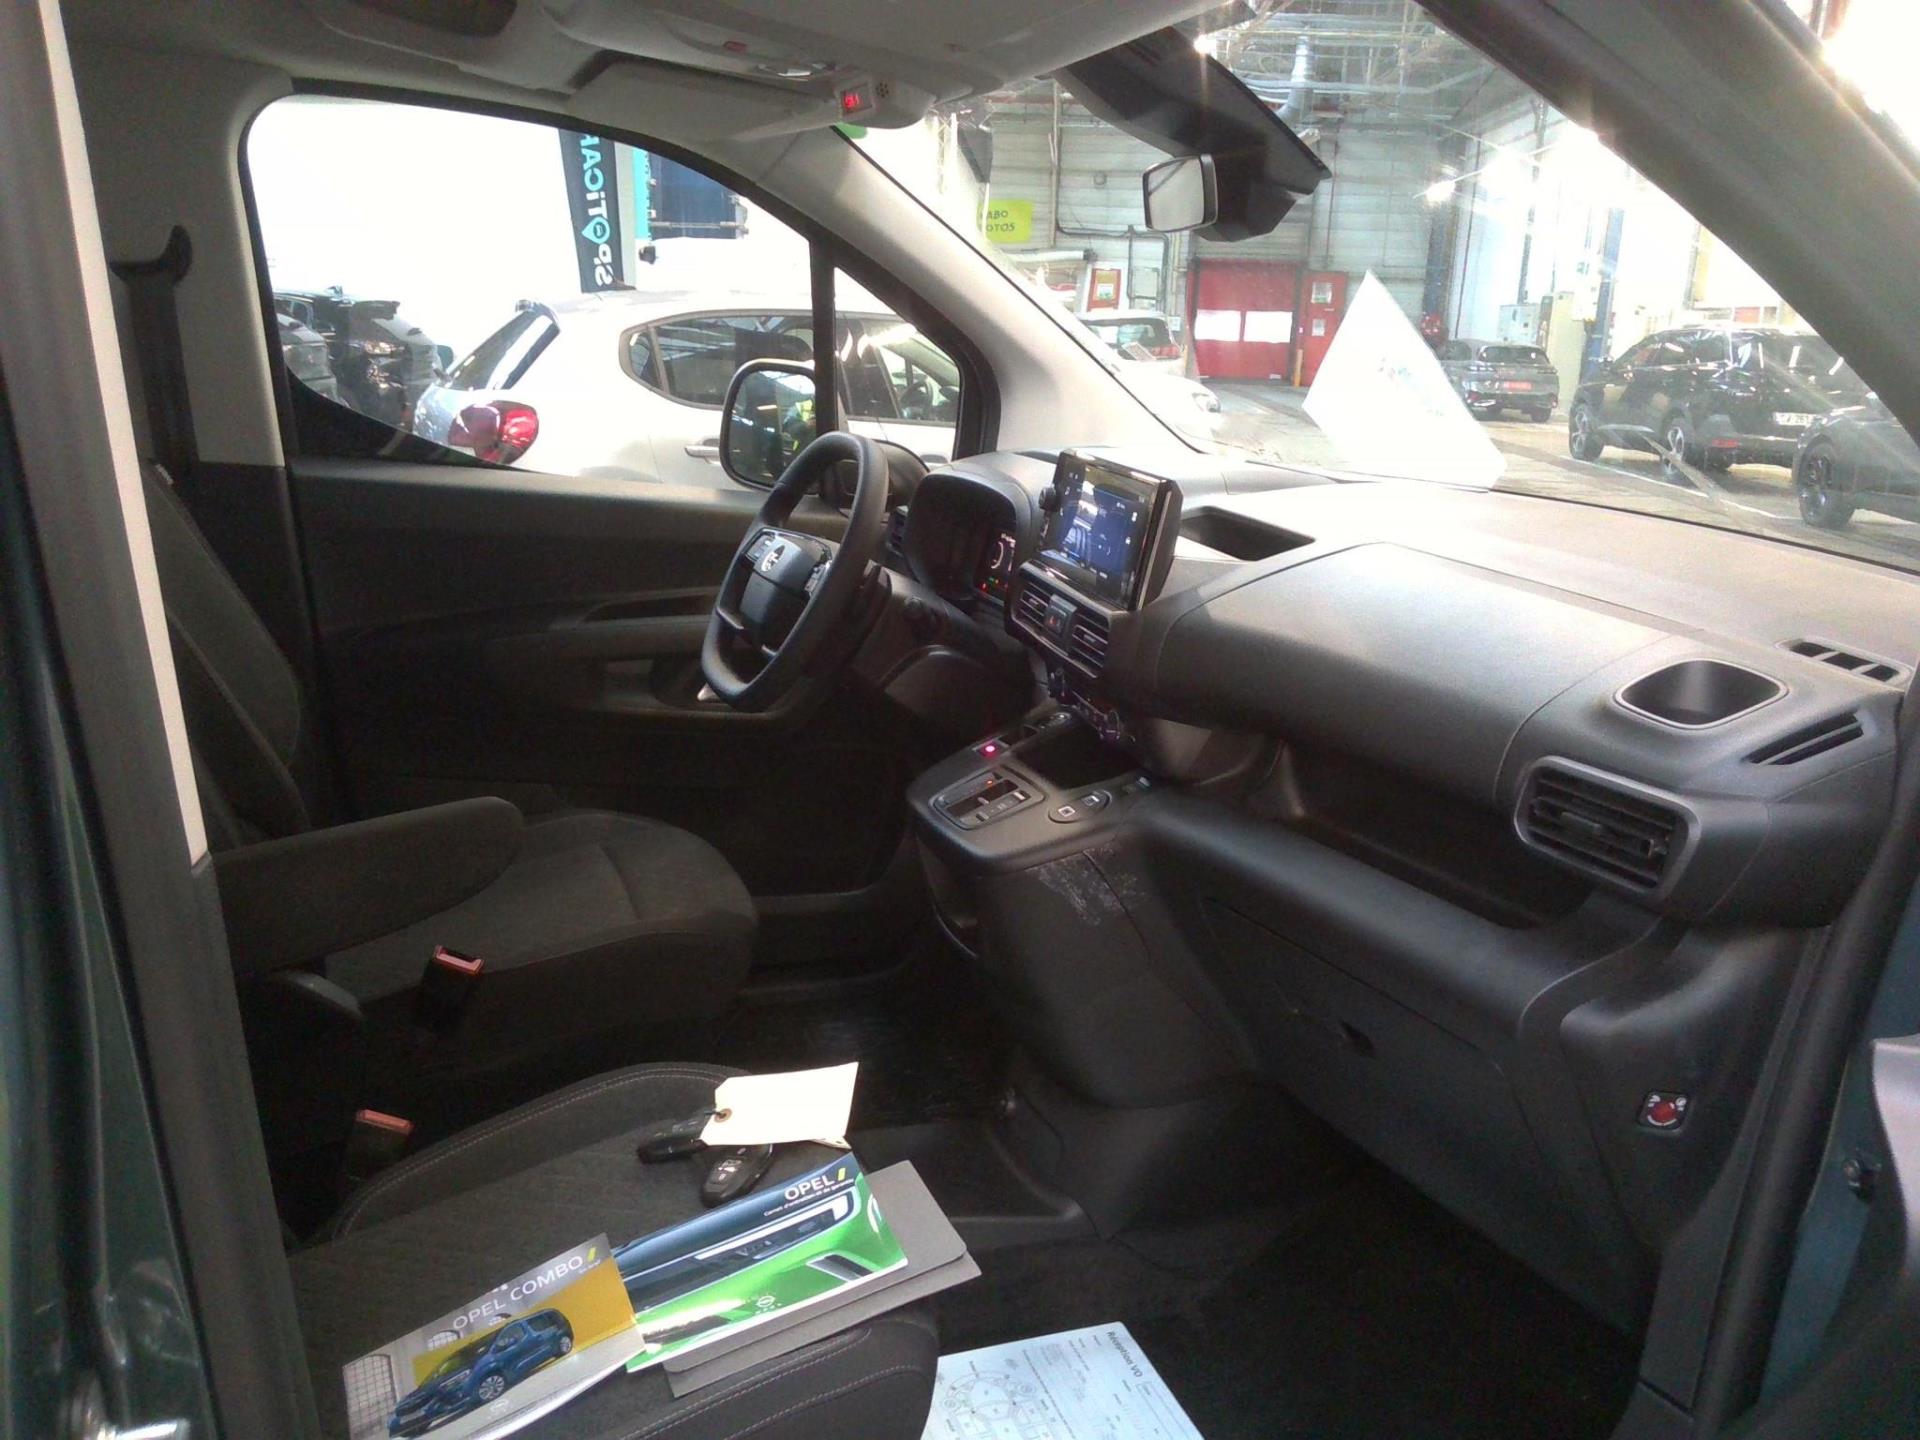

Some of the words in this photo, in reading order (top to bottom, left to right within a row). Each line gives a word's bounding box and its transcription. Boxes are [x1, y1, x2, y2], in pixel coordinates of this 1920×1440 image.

[984, 209, 1009, 220] ABO
[984, 222, 1016, 232] OTOS
[784, 1175, 835, 1200] OPEL
[452, 1299, 507, 1330] OPEL
[509, 1255, 584, 1301] COMBO
